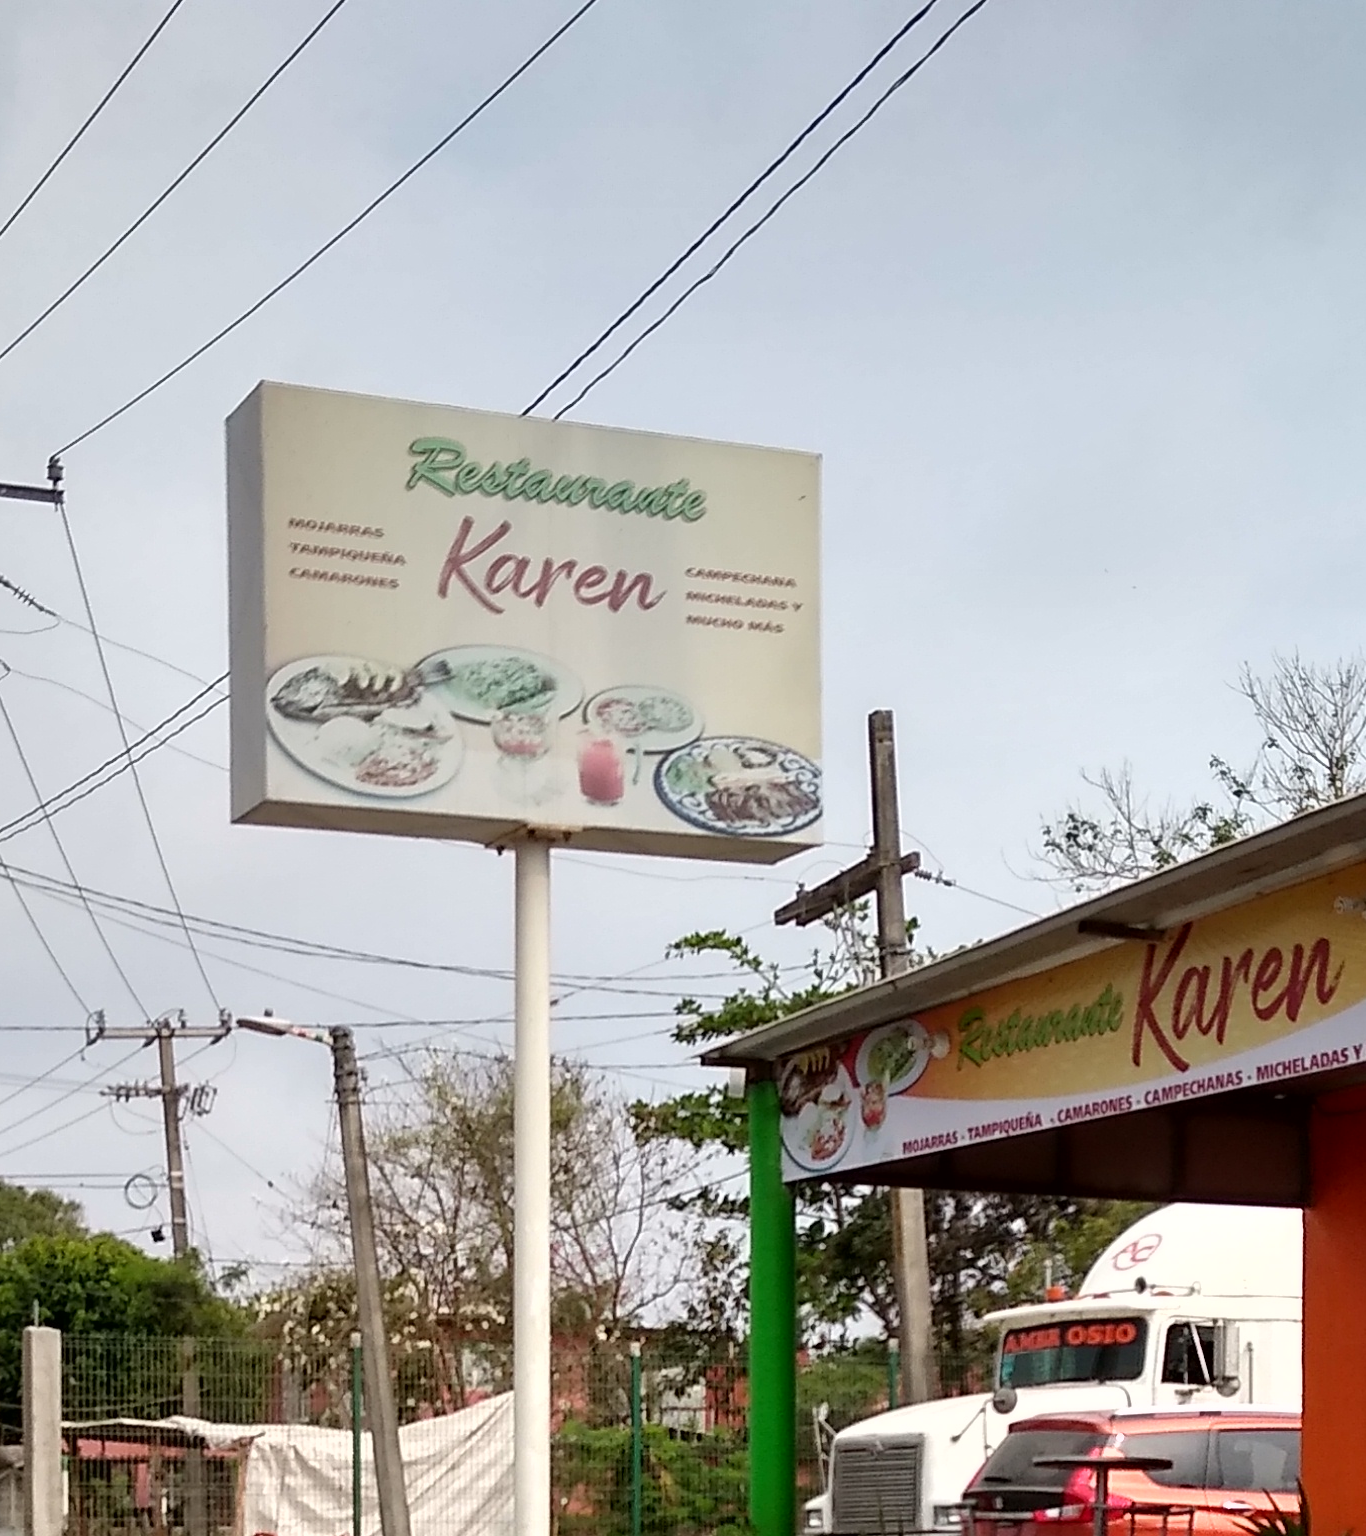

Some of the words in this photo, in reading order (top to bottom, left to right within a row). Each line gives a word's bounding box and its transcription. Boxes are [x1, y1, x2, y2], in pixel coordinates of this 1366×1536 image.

[406, 436, 707, 522] Restaurante
[288, 517, 385, 538] MOJARRAS
[289, 541, 407, 566] TAMPIQUEÑA
[438, 515, 667, 615] Karen
[288, 567, 400, 589] CAMARONES
[685, 567, 797, 588] CAMPECHANA
[685, 591, 788, 611] MICHELADAS
[792, 601, 803, 612] Y
[686, 614, 744, 630] MUCHO
[957, 982, 1125, 1071] Restaurante
[1132, 921, 1345, 1072] Karen
[902, 1131, 958, 1154] MOJARRAS
[967, 1111, 1043, 1137] TAMPIQUEÑA
[1057, 1095, 1132, 1123] CAMARONES
[1144, 1072, 1243, 1107] CAMPECHANAS
[1256, 1047, 1349, 1082] MICHELADAS
[1352, 1043, 1363, 1060] Y
